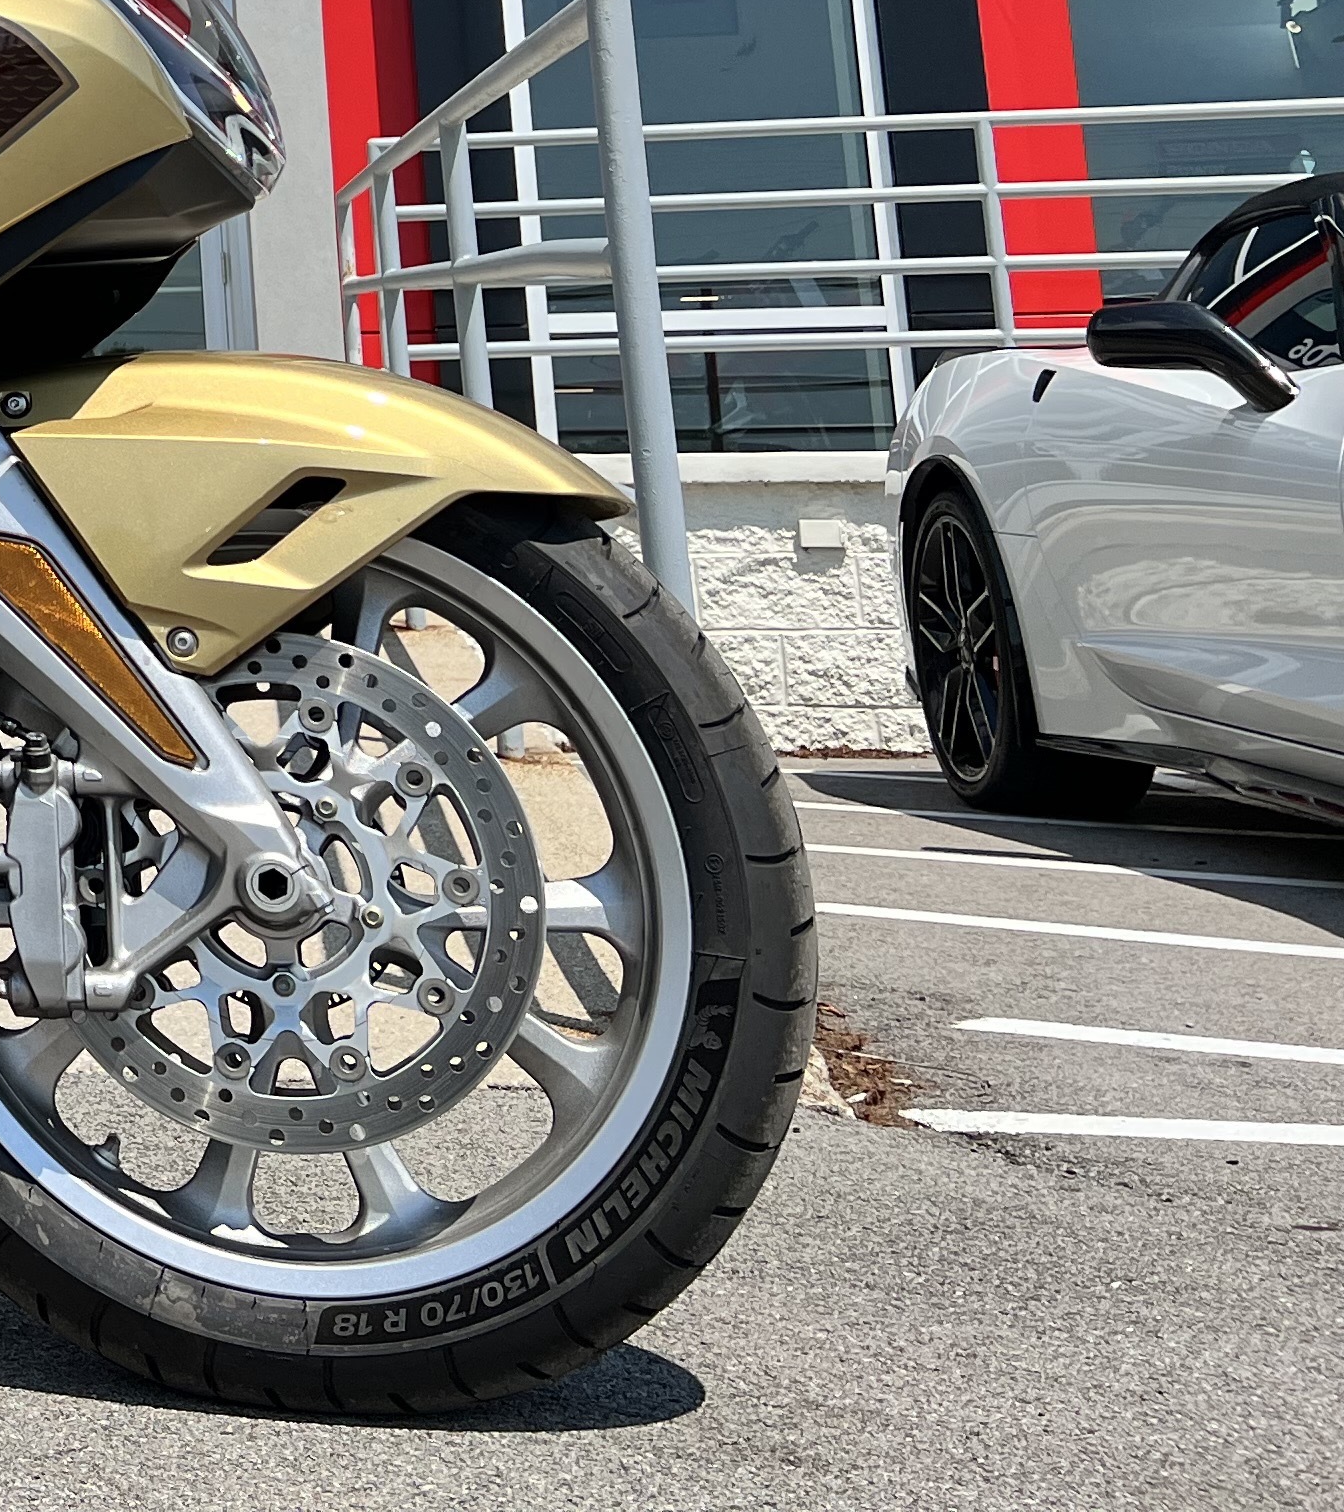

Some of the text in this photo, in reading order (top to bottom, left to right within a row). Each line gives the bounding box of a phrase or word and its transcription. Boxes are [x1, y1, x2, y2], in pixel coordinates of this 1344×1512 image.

[565, 1058, 713, 1264] MICHELIN
[333, 1263, 540, 1337] 130/70 R 18
